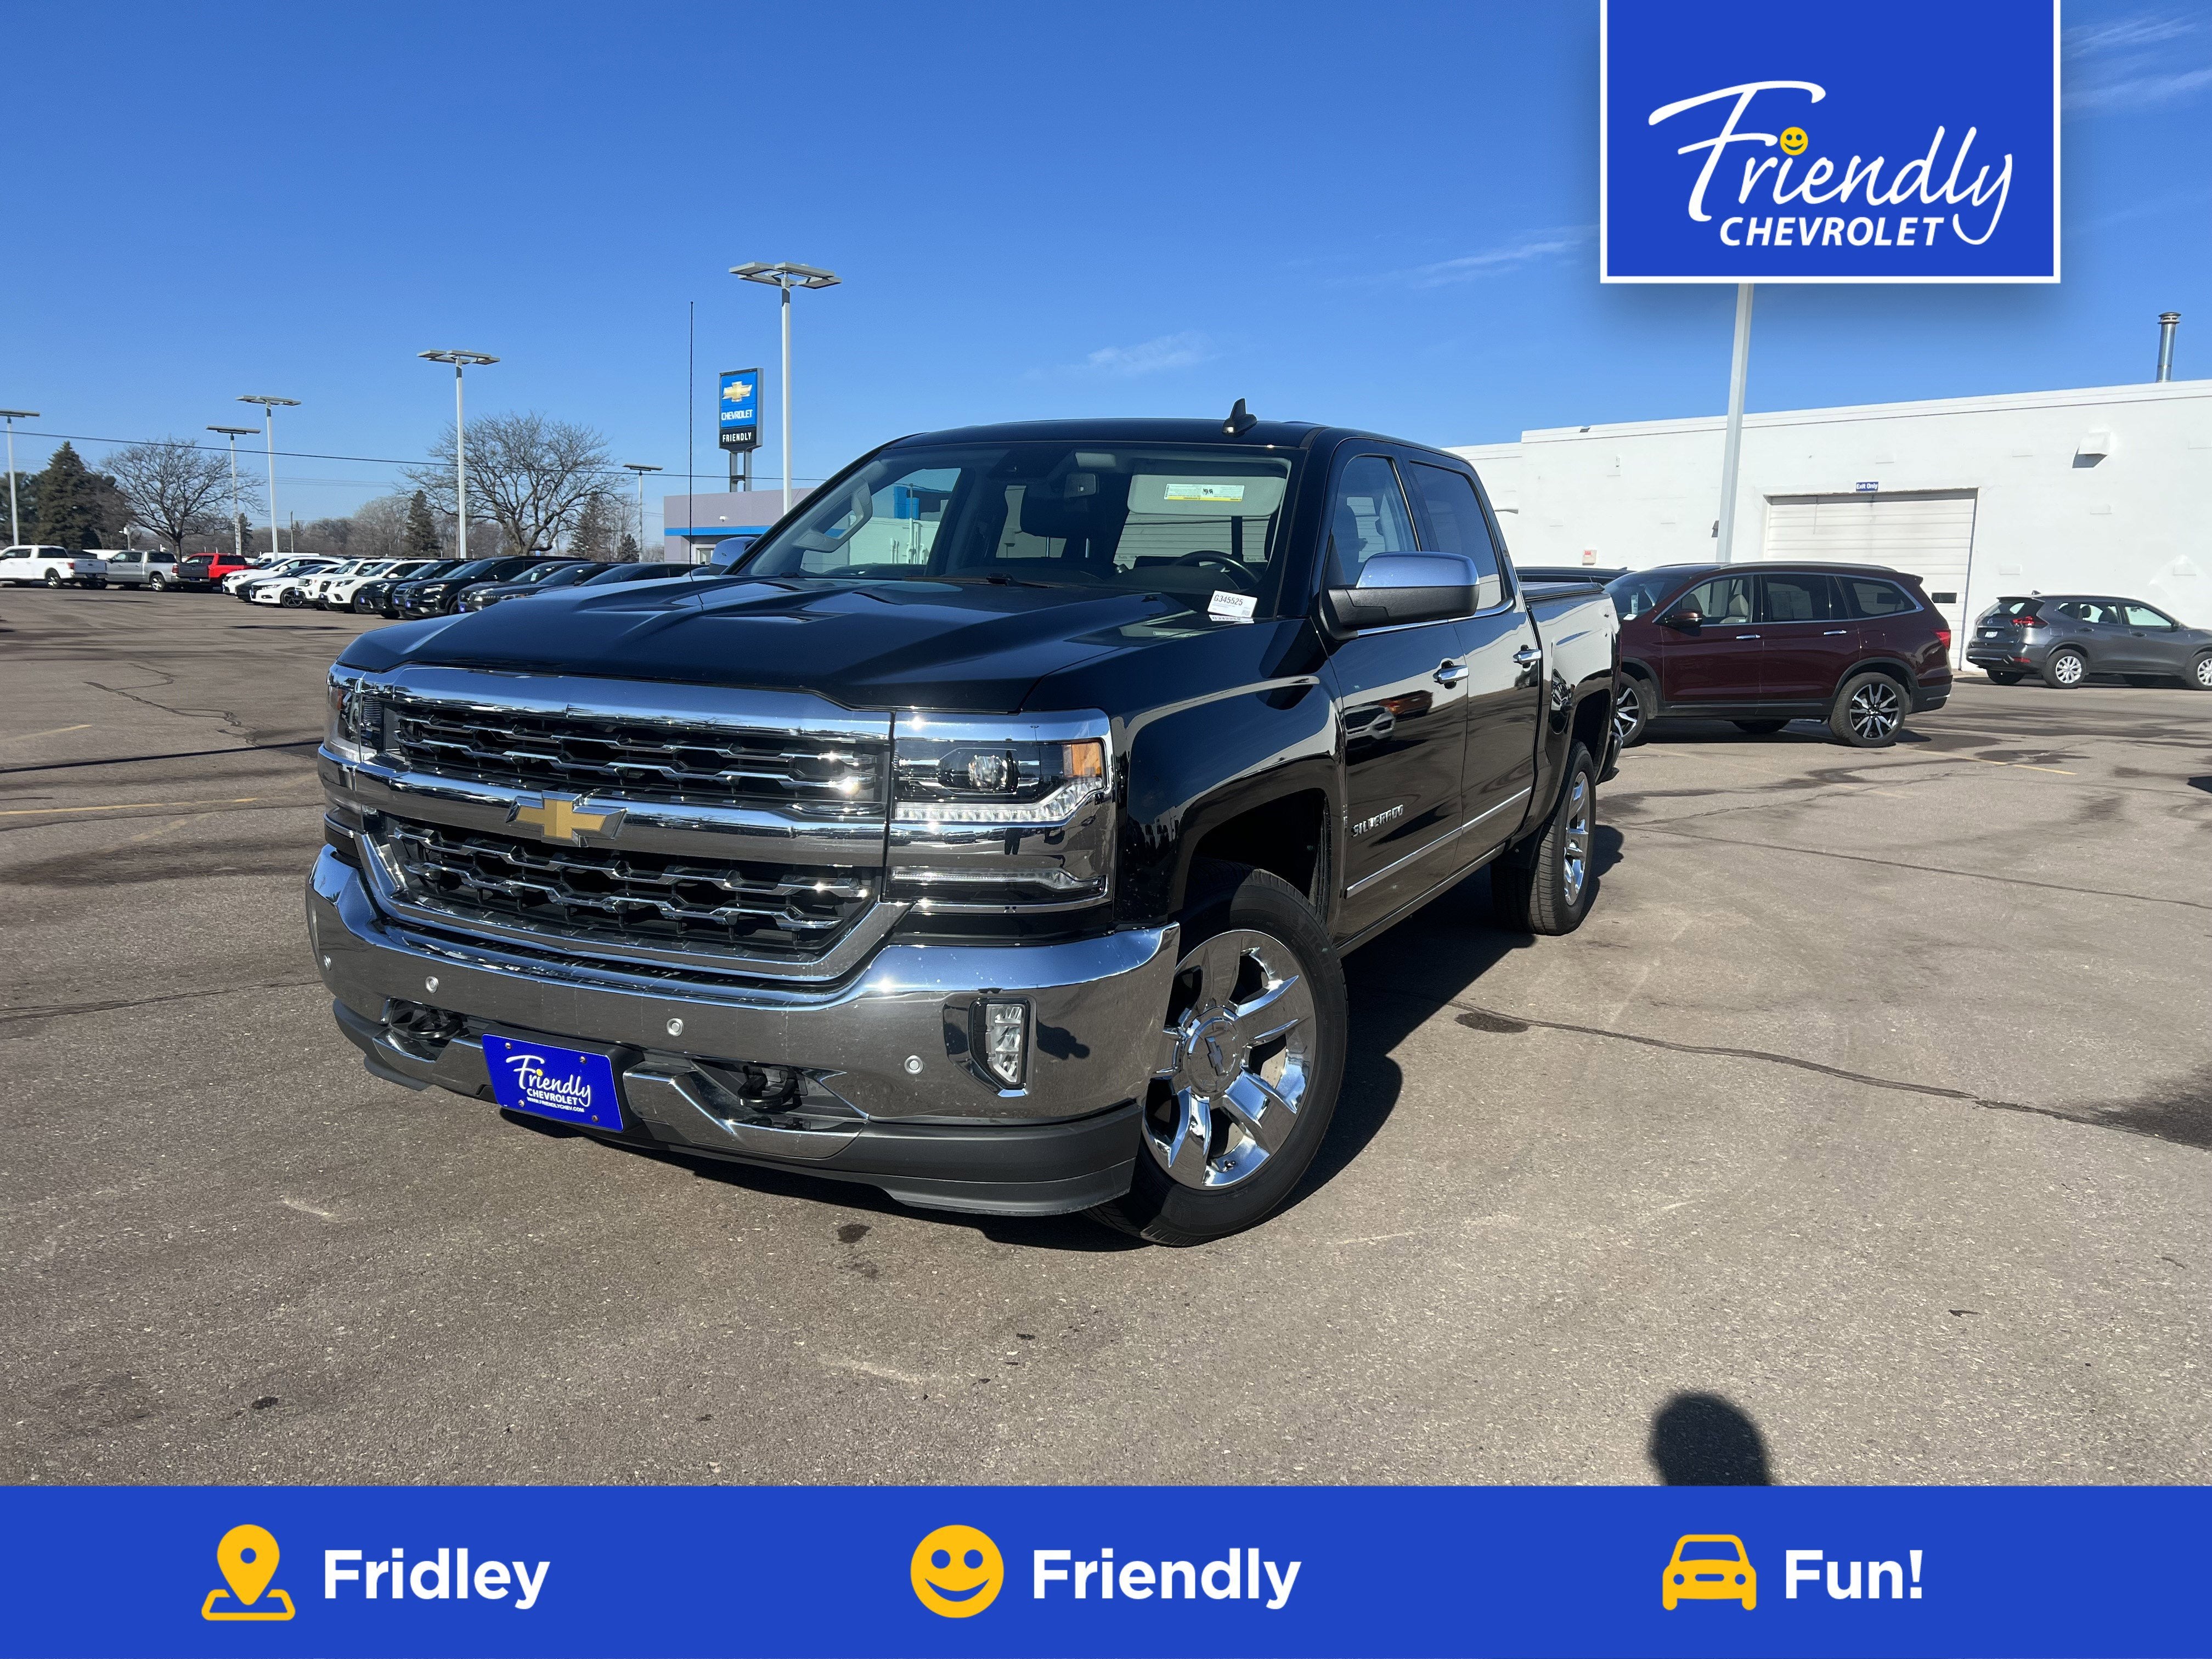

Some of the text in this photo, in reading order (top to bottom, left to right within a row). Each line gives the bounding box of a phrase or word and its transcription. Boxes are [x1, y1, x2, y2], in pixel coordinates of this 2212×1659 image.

[721, 409, 753, 421] CHEVROLET
[722, 432, 752, 443] FRIENDLY
[1214, 594, 1243, 606] G345525
[1351, 804, 1404, 838] SILVERADO
[506, 1055, 590, 1107] Friendly
[527, 1088, 578, 1105] CHEVROLET
